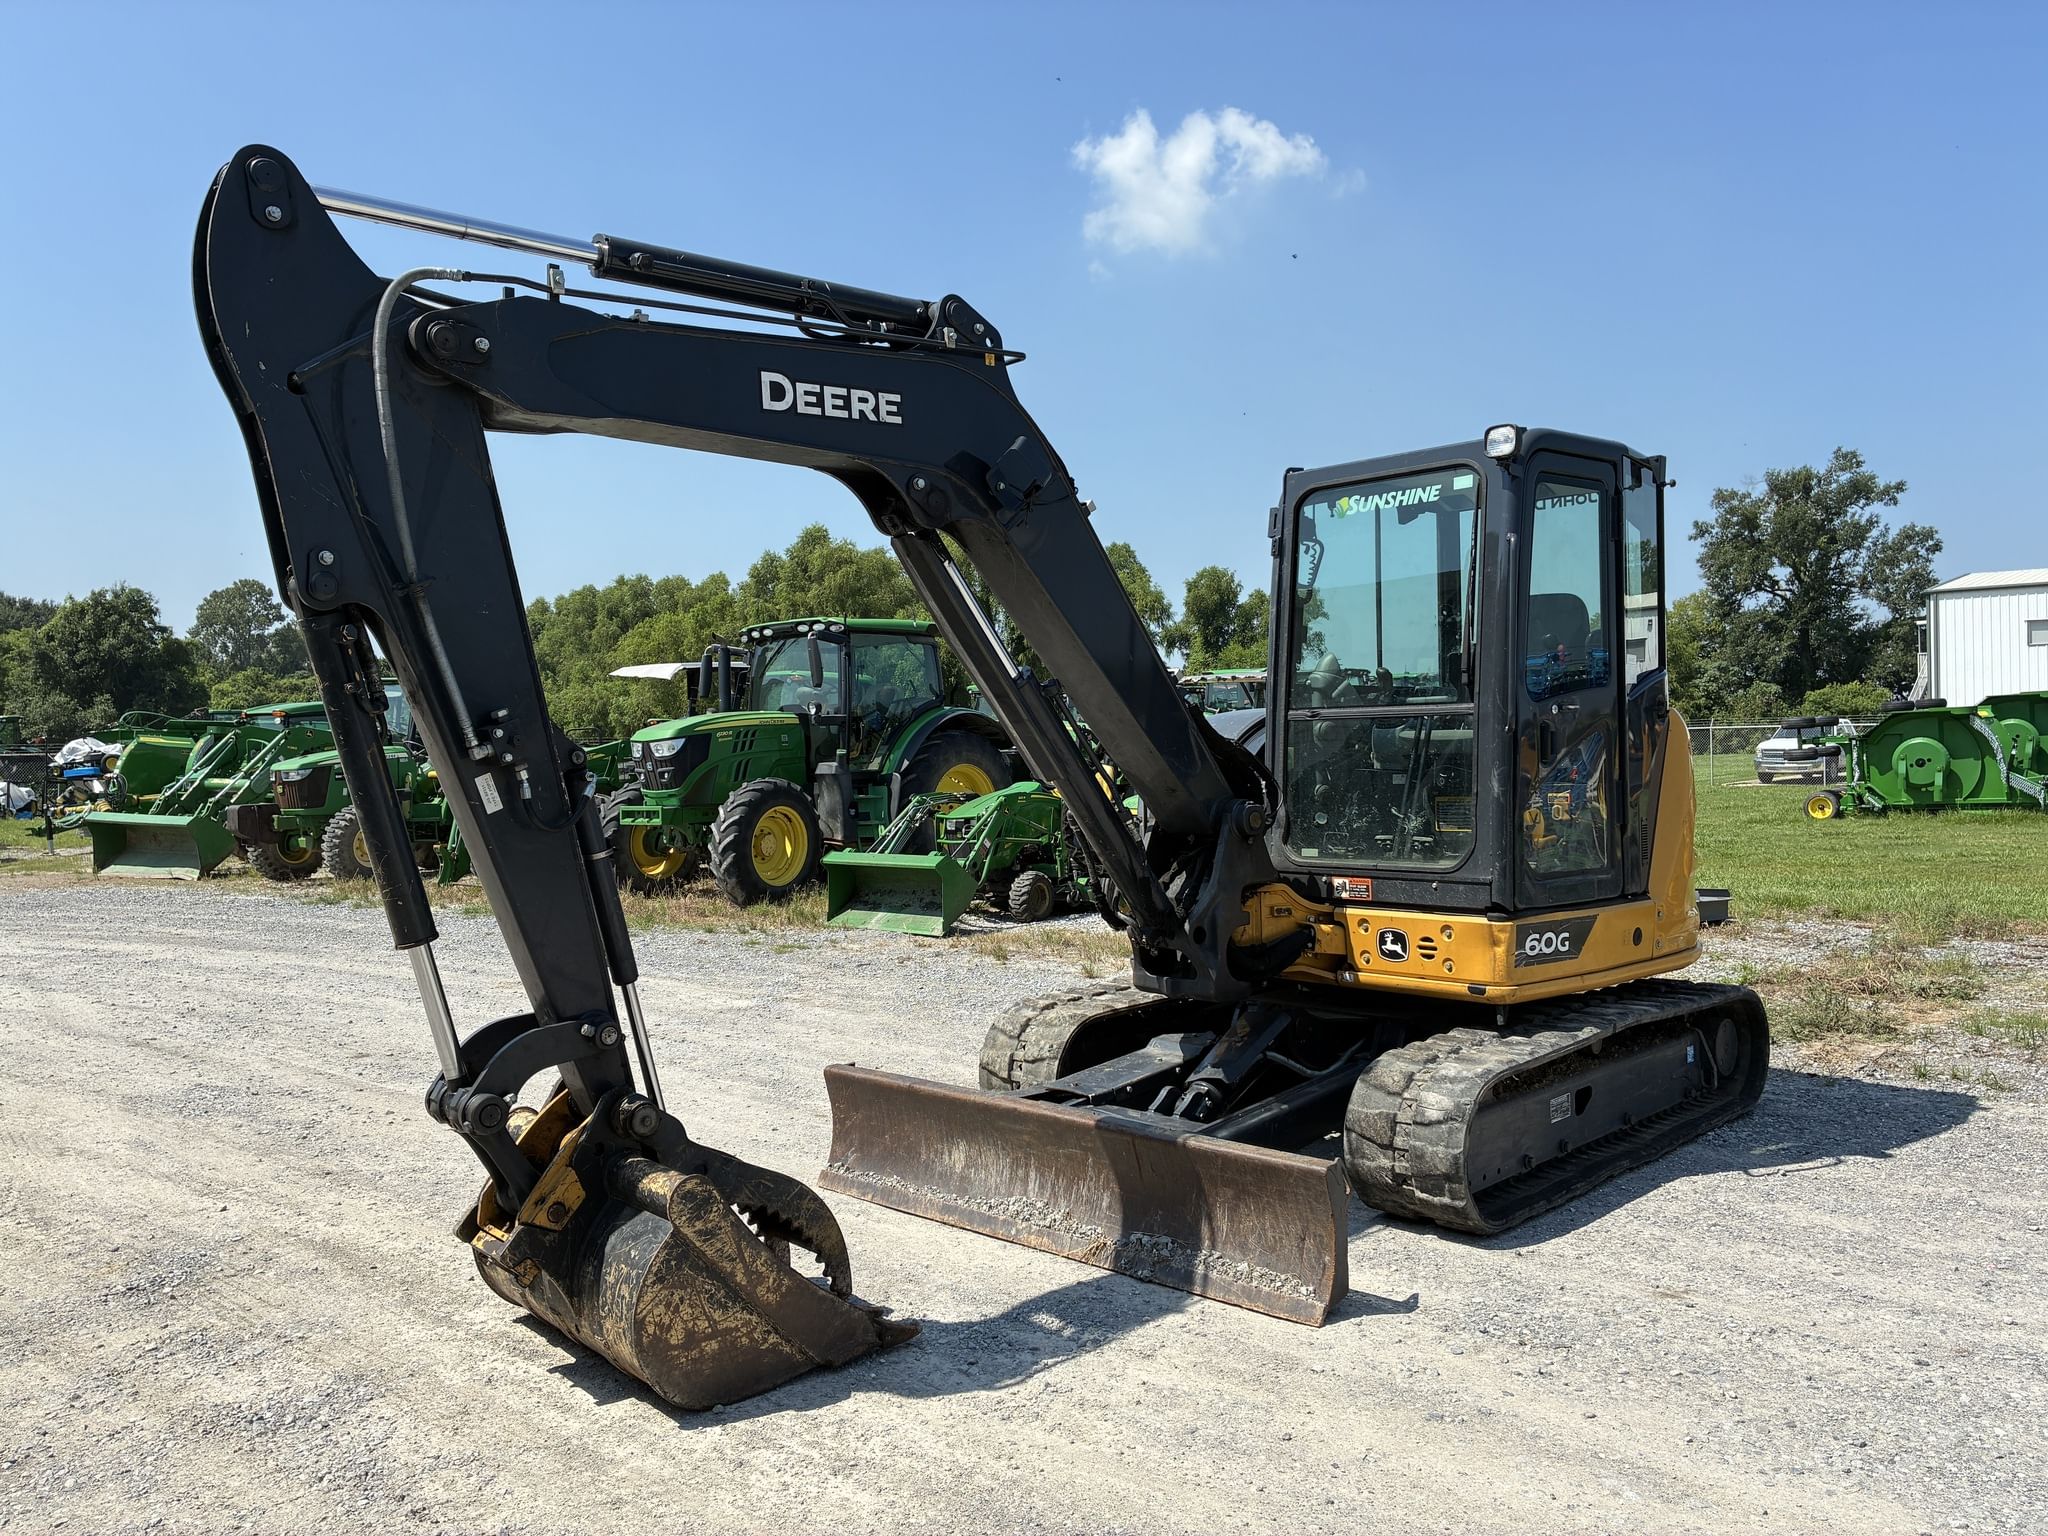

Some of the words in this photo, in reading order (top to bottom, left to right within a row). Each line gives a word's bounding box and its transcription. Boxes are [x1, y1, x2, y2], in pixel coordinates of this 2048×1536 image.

[760, 370, 903, 425] DEERE
[1346, 484, 1442, 515] SUNSHINE
[1525, 931, 1570, 956] 60G
